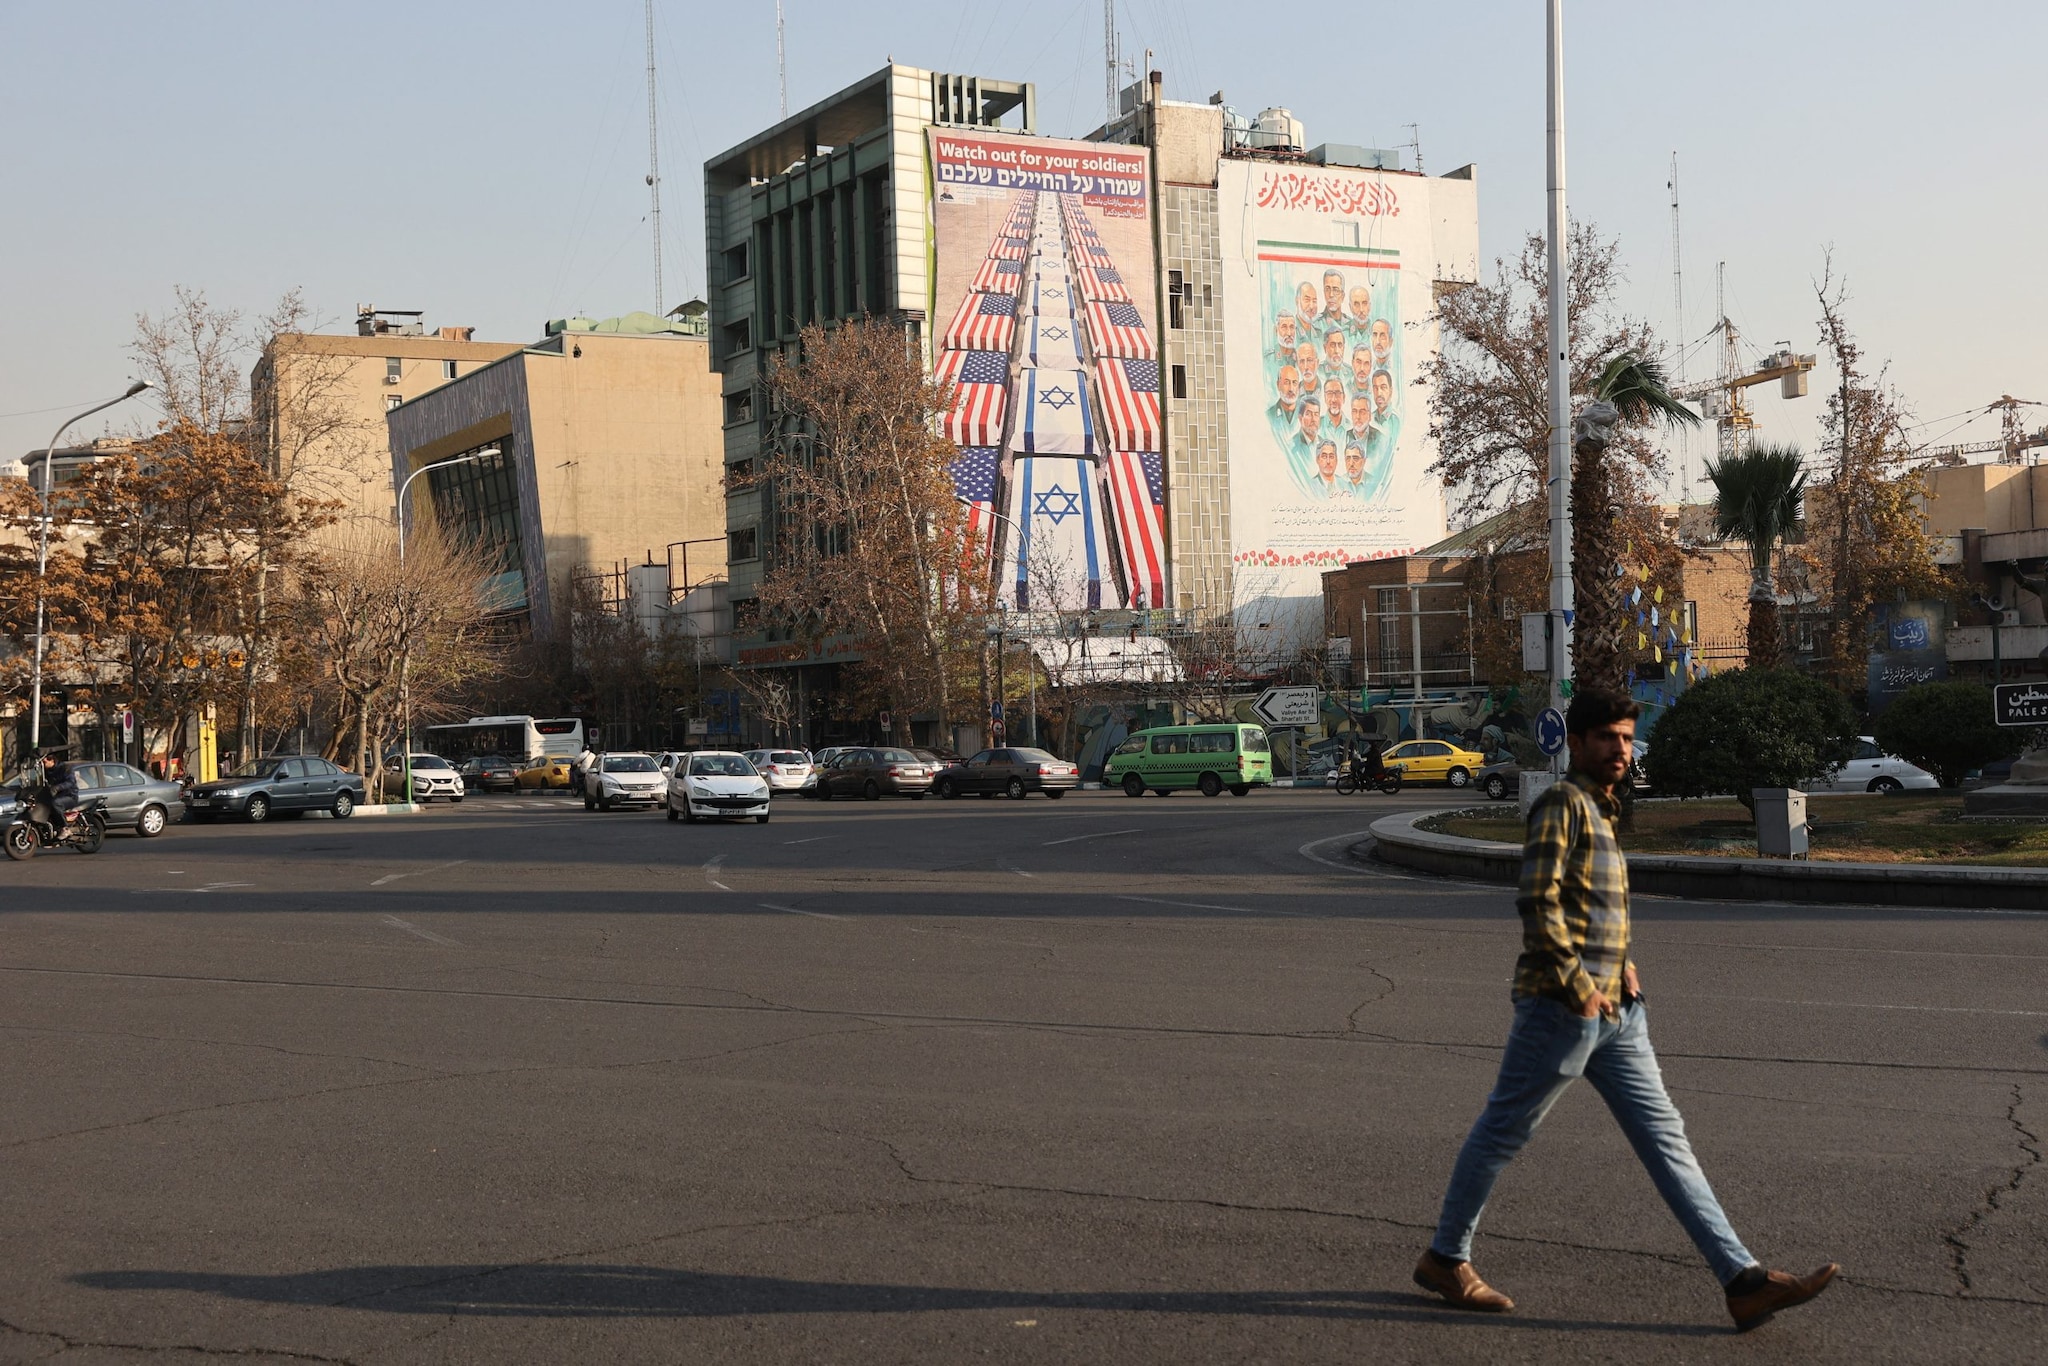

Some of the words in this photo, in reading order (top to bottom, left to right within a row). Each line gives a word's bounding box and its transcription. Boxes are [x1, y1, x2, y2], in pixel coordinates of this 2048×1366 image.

[939, 141, 988, 161] Watch
[991, 149, 1016, 163] out
[1020, 150, 1042, 166] for
[1044, 156, 1079, 171] your
[1082, 156, 1143, 174] soldiers!
[940, 160, 993, 184] שלכם
[997, 165, 1067, 191] החיילים
[1071, 170, 1094, 193] על
[1098, 176, 1142, 196] שמרו
[1285, 700, 1309, 708] شریعتی
[1286, 691, 1308, 699] ولیعصر
[2008, 706, 2048, 718] PALES
